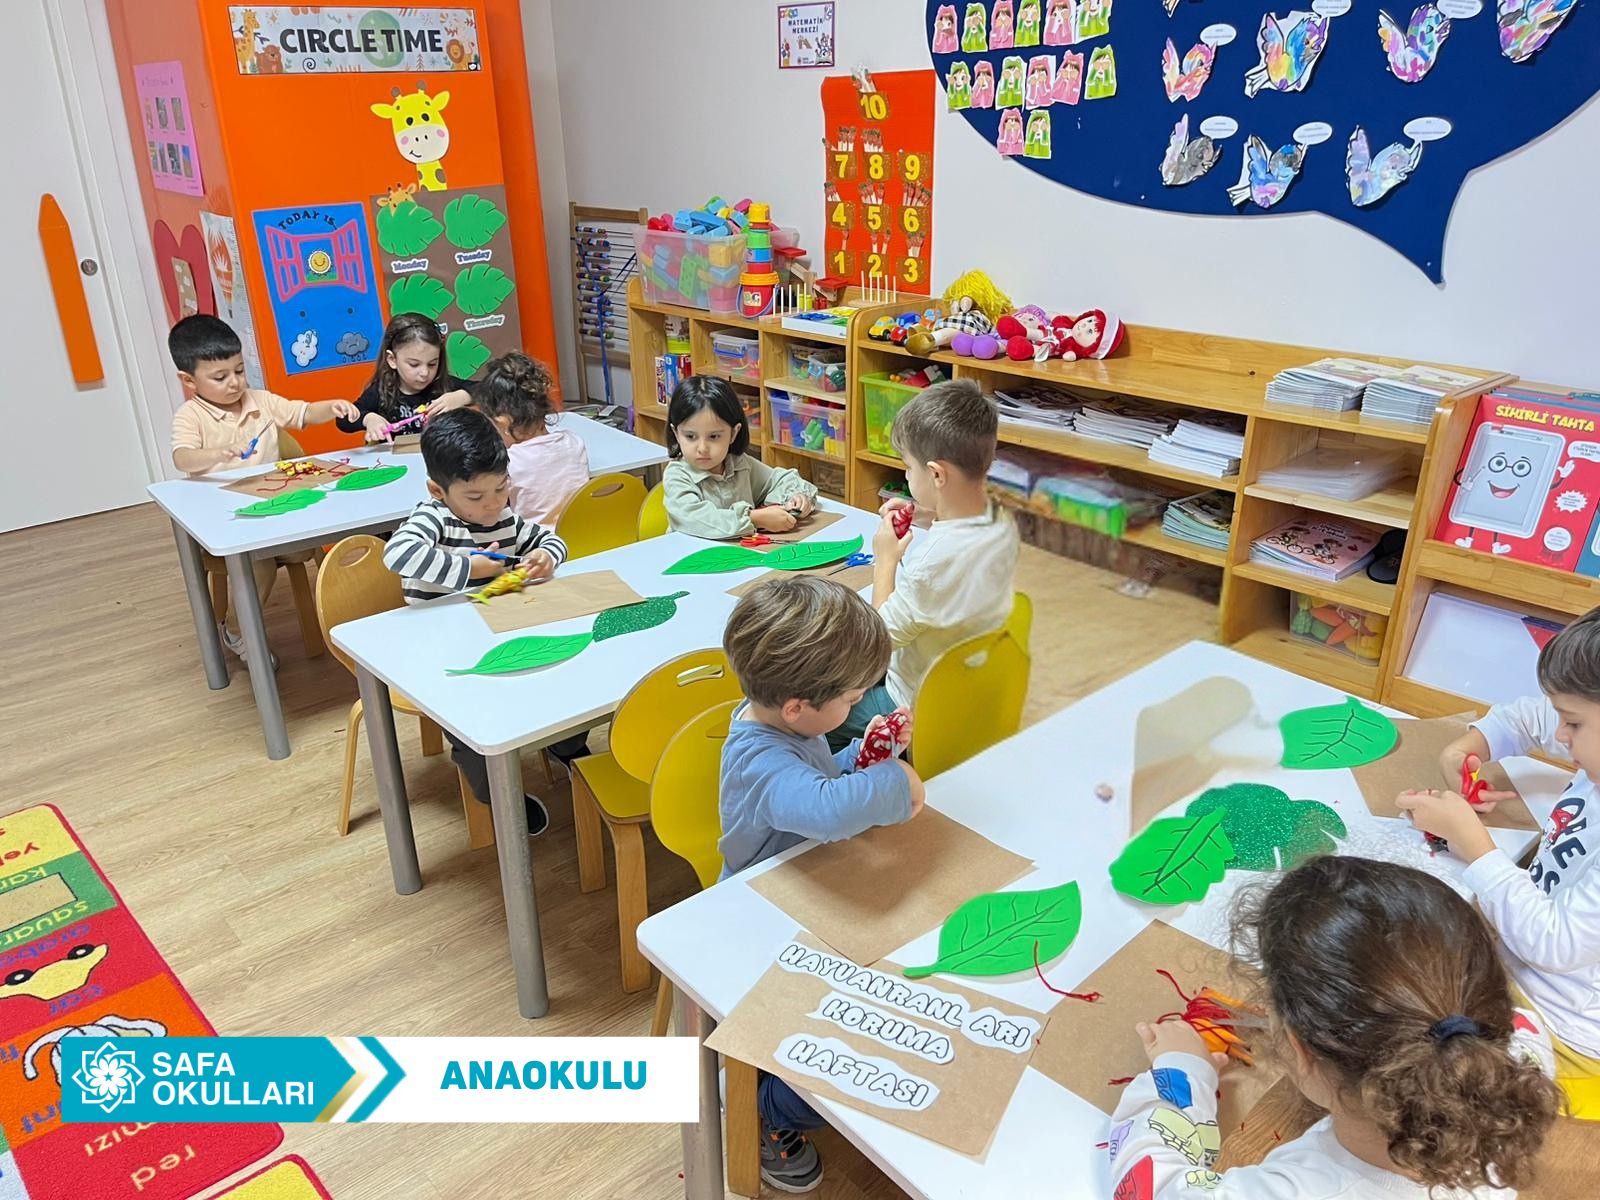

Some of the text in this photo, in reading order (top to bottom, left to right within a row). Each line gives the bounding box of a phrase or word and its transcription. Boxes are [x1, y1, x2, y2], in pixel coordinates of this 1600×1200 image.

[279, 28, 443, 54] CIRCLE TIME
[860, 94, 887, 120] 10
[835, 154, 920, 181] 7 8 9
[278, 209, 320, 230] TODAY
[832, 202, 920, 232] 4 5 6
[456, 251, 491, 263] Tuesday
[834, 251, 919, 283] 1 2 3
[1495, 405, 1596, 432] SİHİRLİ TAHTA
[0, 900, 89, 946] squar
[822, 998, 950, 1059] KORUMA
[788, 1040, 929, 1107] HAFTASI
[130, 1144, 196, 1192] red
